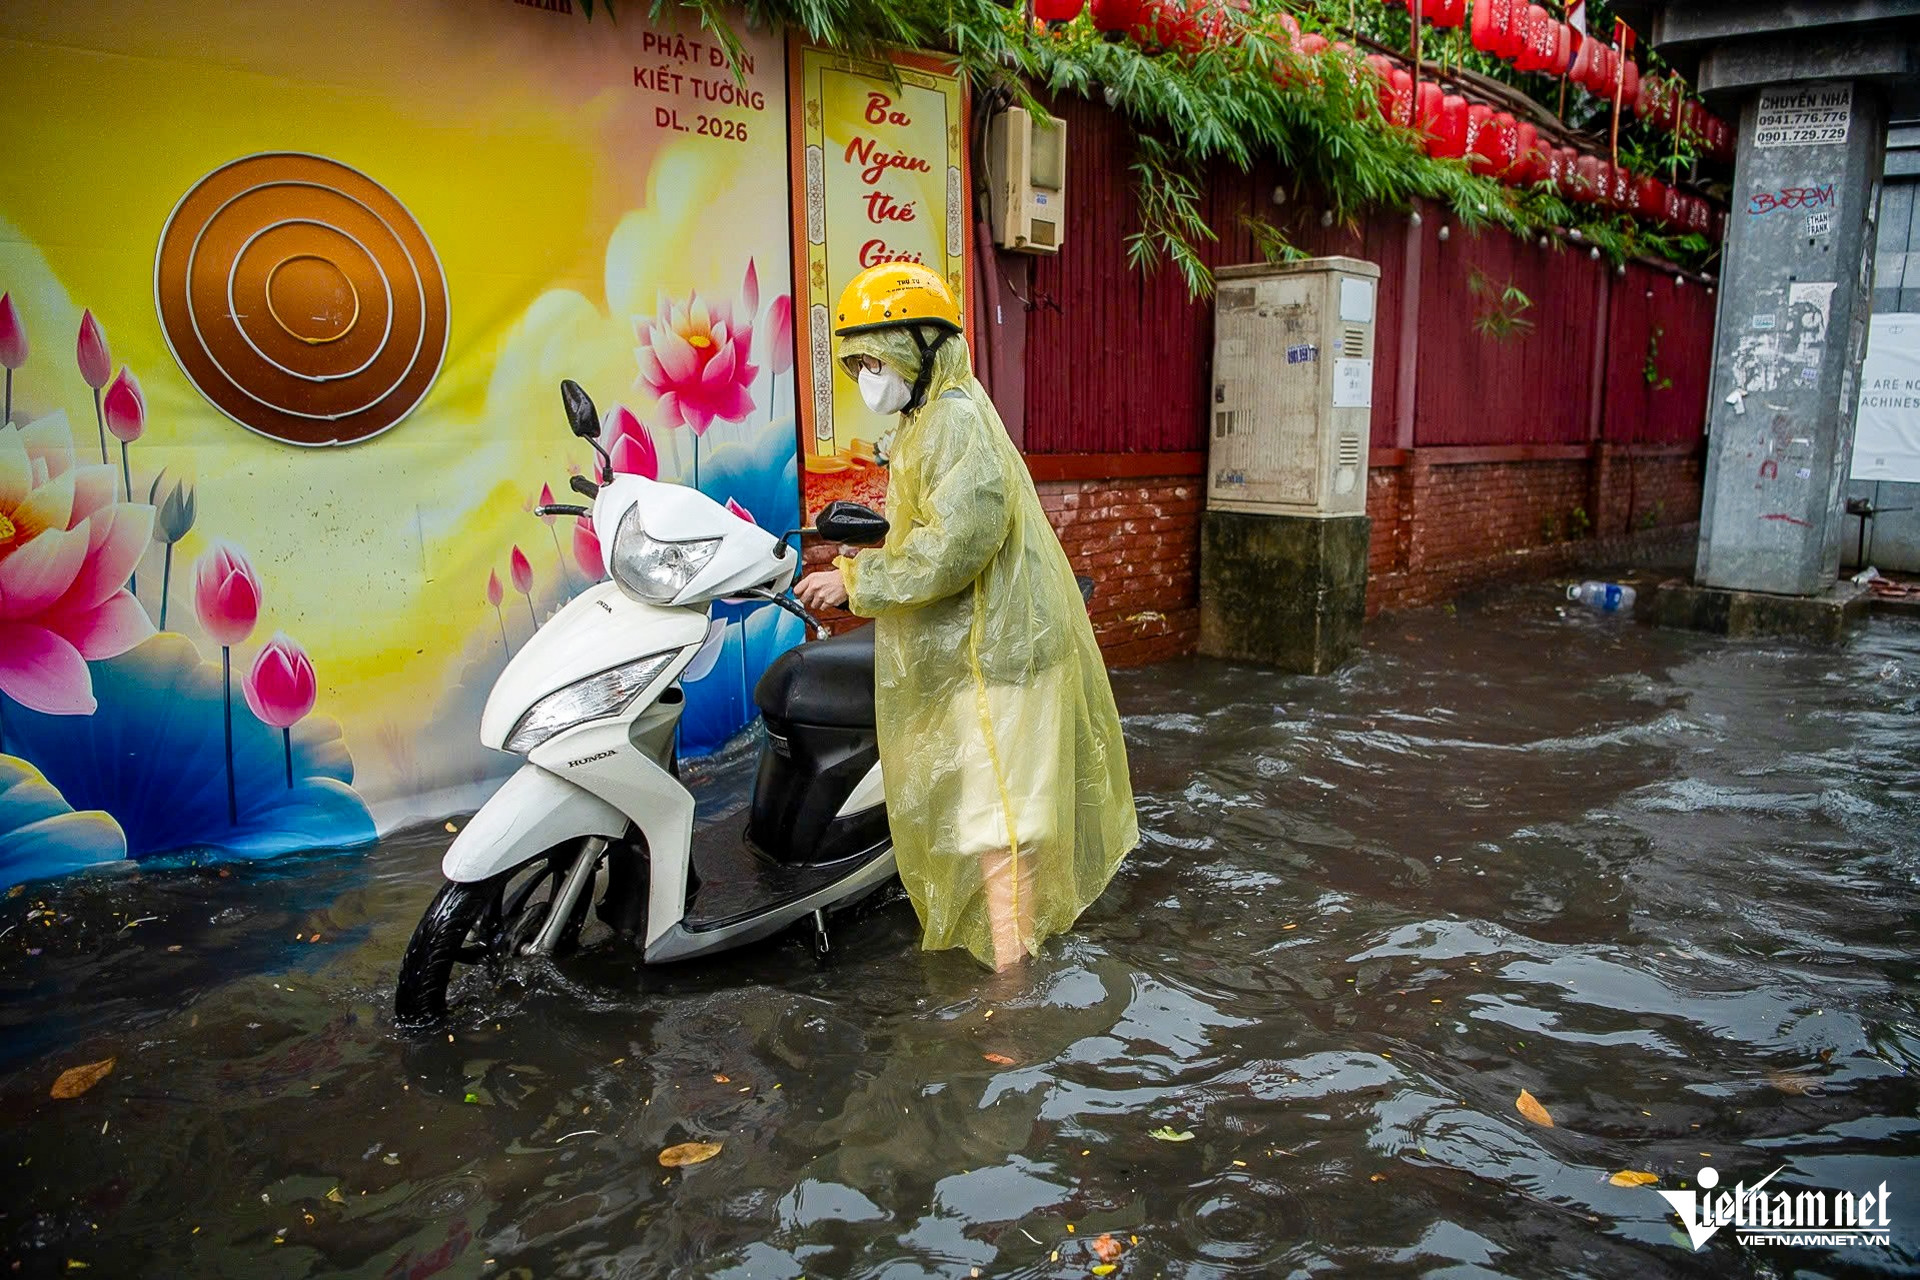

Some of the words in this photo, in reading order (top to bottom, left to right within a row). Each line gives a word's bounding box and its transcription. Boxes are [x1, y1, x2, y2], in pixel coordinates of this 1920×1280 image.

[643, 31, 702, 66] PHẬT
[709, 46, 754, 75] ĐN
[634, 64, 683, 95] KIẾT
[690, 78, 765, 111] TƯỜNG
[865, 91, 911, 127] Ba
[1759, 111, 1847, 126] 0941.776.776
[656, 106, 689, 132] DL.
[697, 114, 747, 142] 2026
[1757, 128, 1845, 142] 0901.729.729
[844, 136, 931, 185] Ngàn
[1873, 379, 1899, 390] ARE
[1861, 397, 1920, 409] ACHINES
[568, 749, 619, 768] HONDA
